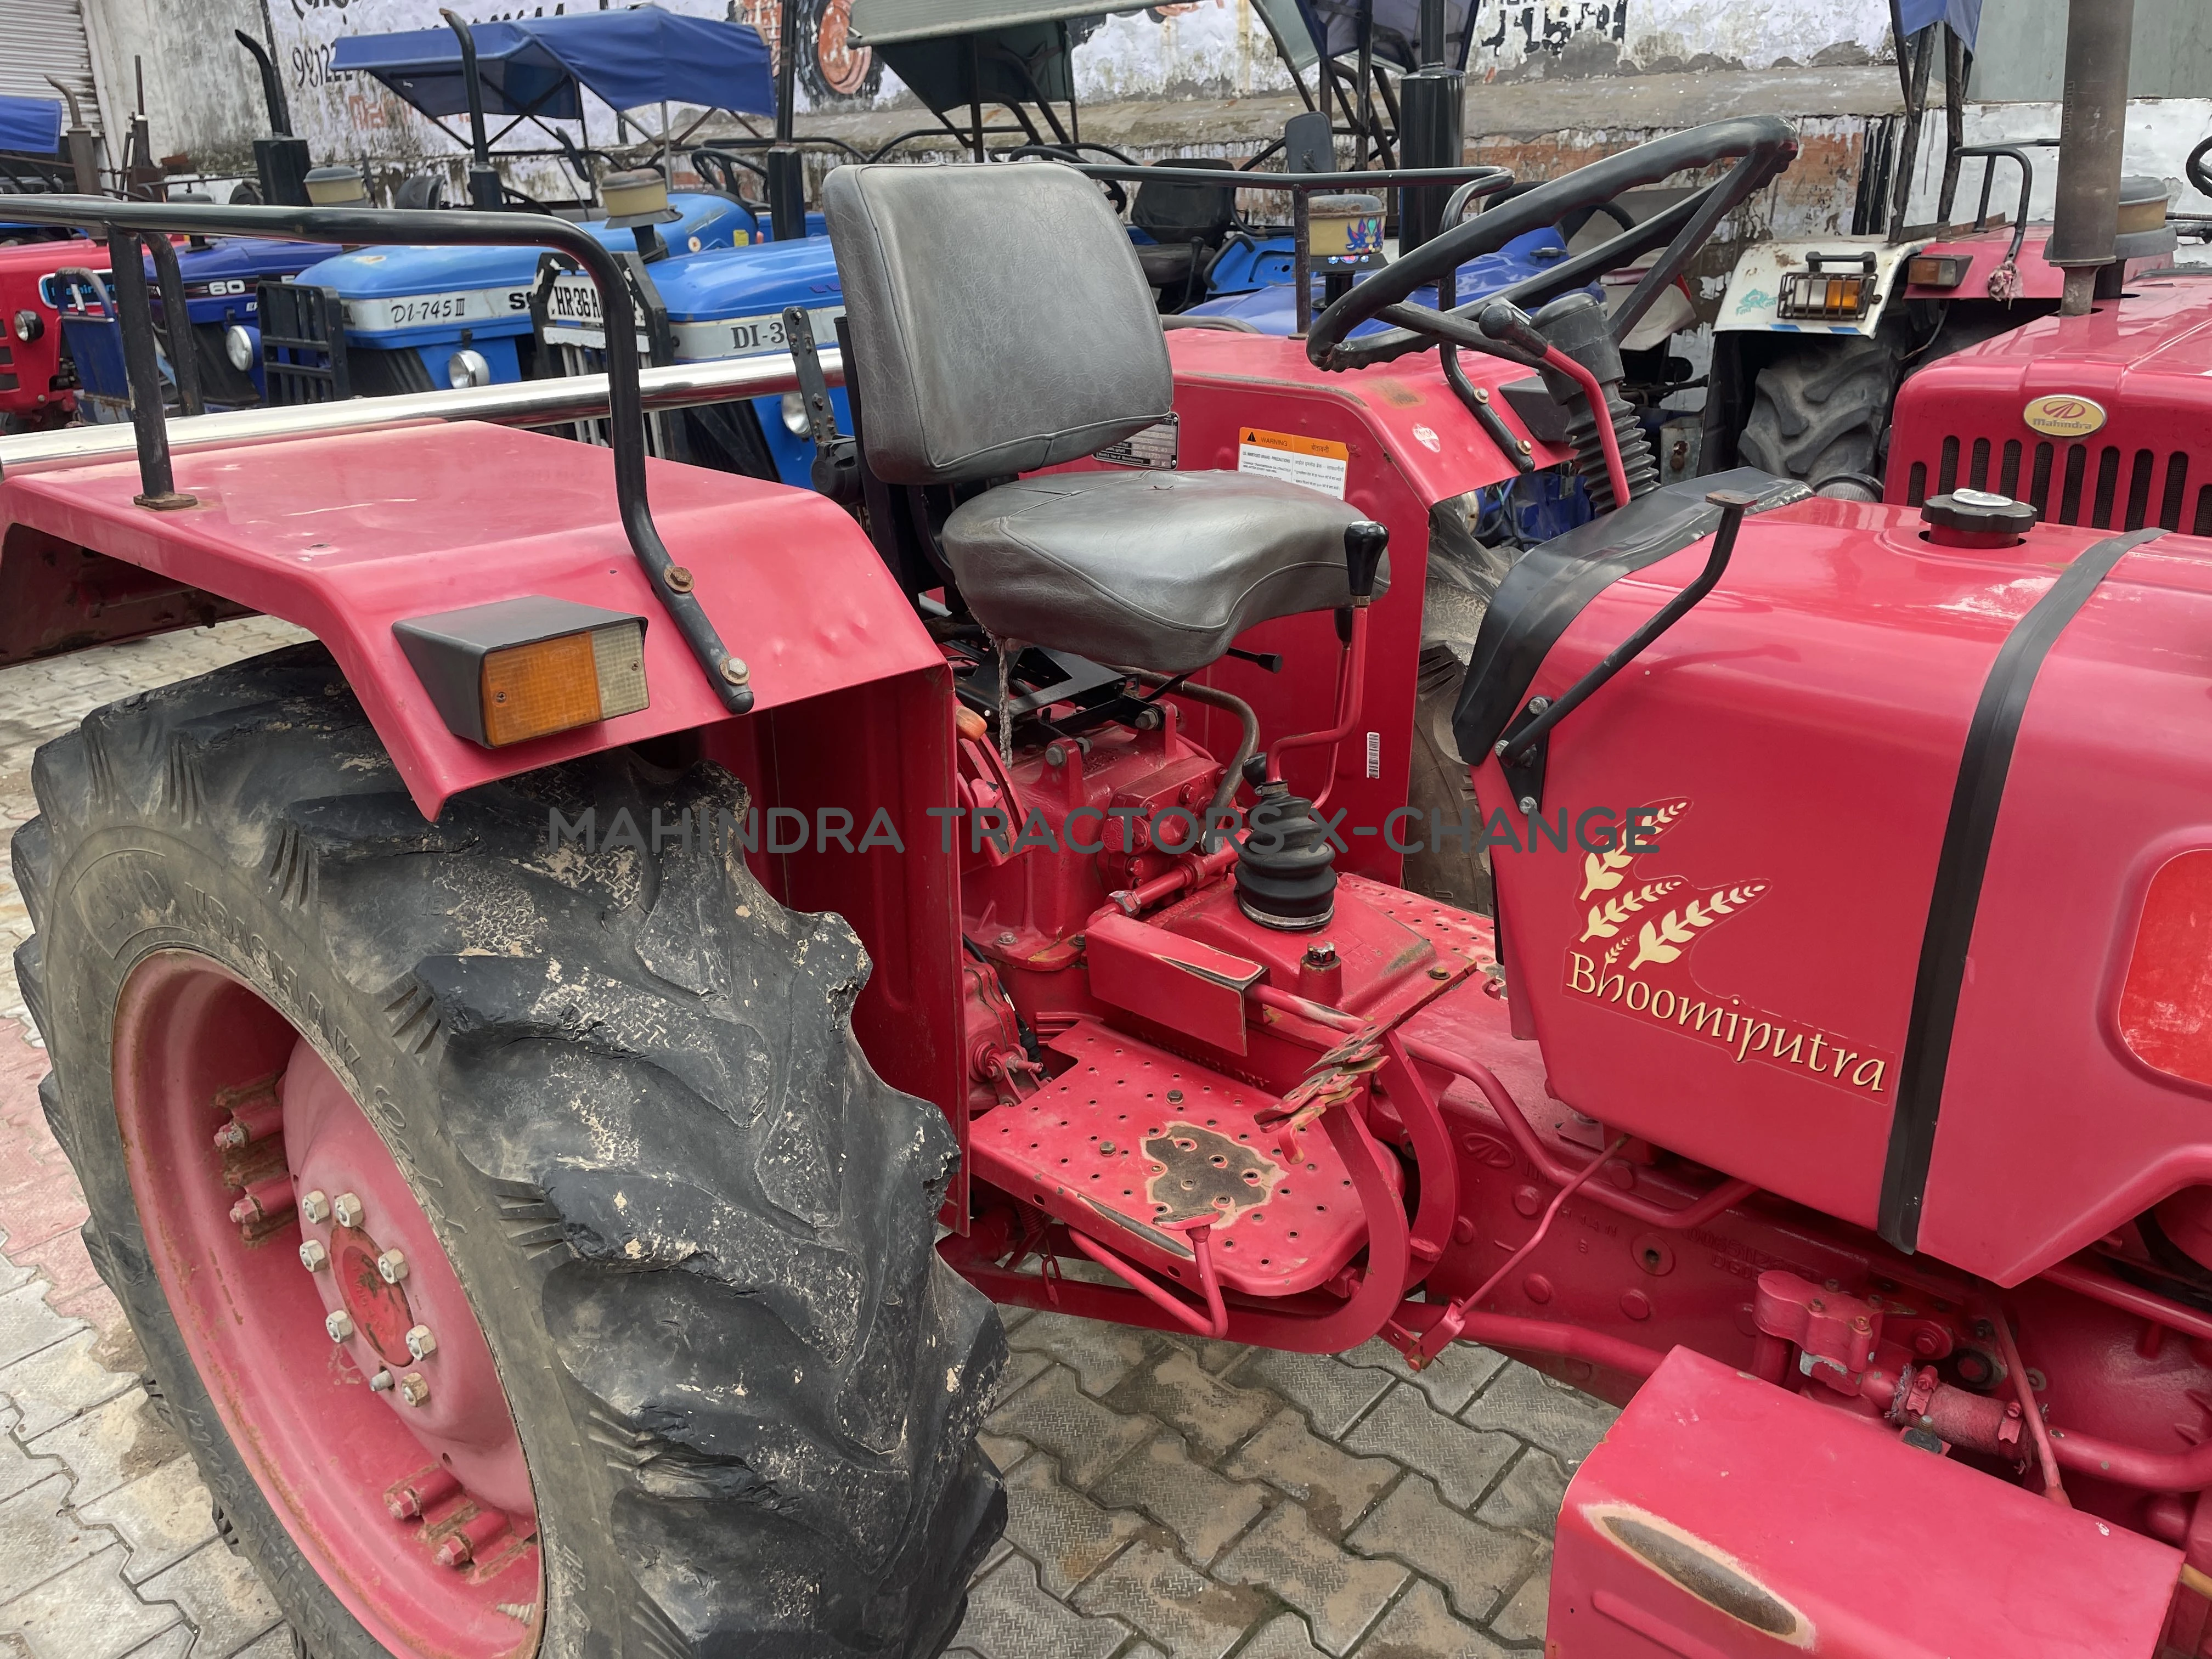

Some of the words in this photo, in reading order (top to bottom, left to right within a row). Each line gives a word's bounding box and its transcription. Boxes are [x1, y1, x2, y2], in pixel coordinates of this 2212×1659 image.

[208, 279, 246, 296] 60
[1261, 437, 1288, 447] WARNING
[1566, 934, 1885, 1093] Bhoomiputra
